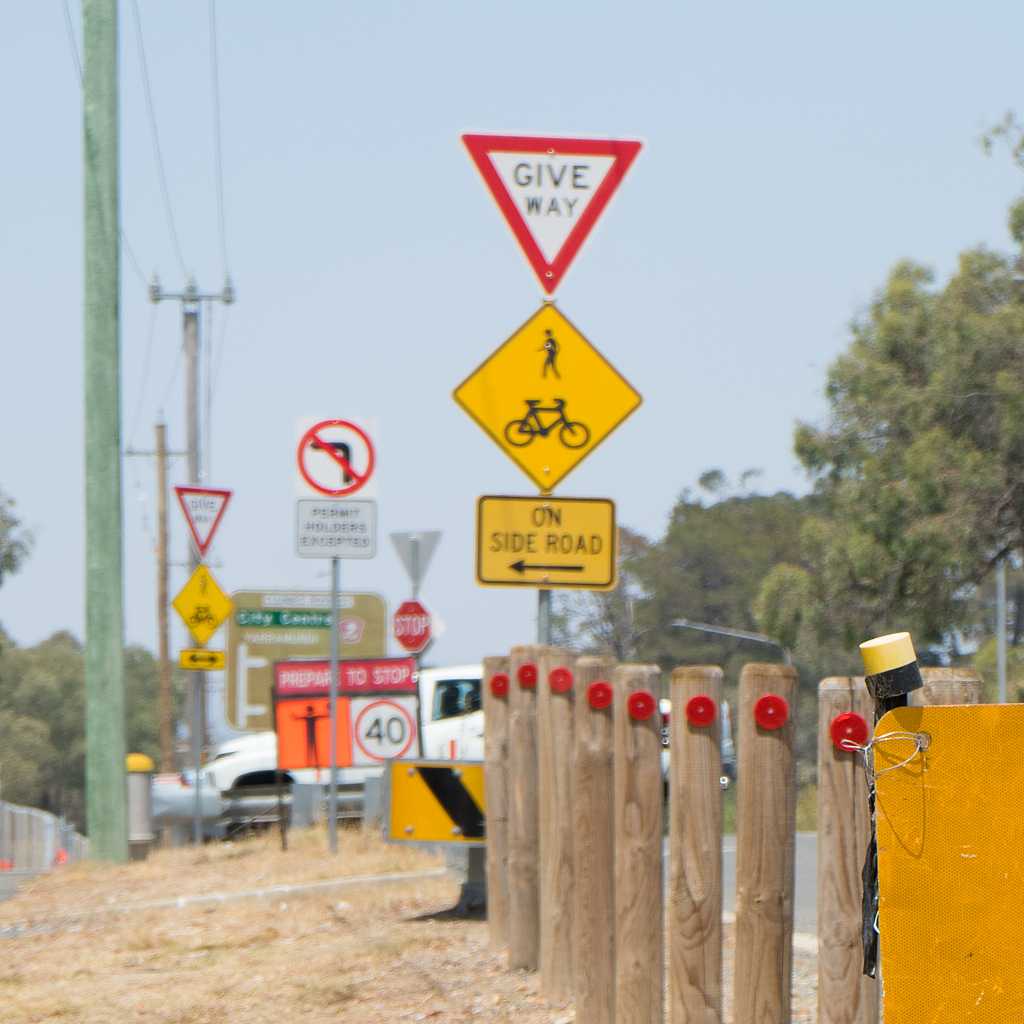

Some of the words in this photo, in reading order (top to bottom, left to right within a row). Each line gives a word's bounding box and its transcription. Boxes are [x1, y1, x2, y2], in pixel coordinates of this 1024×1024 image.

[513, 163, 590, 189] GIVE
[525, 197, 578, 218] WAY
[190, 499, 217, 513] GIVE
[311, 508, 359, 519] PERMIT
[532, 507, 562, 527] ON
[305, 522, 367, 534] HOLDERS
[301, 536, 370, 548] EXCEPTED
[491, 532, 538, 553] SIDE
[546, 534, 603, 555] ROAD
[239, 611, 273, 627] City
[280, 611, 333, 626] Centre
[394, 614, 431, 637] STOP
[346, 668, 368, 686] TO
[372, 665, 411, 685] STOP
[364, 717, 405, 746] 40
